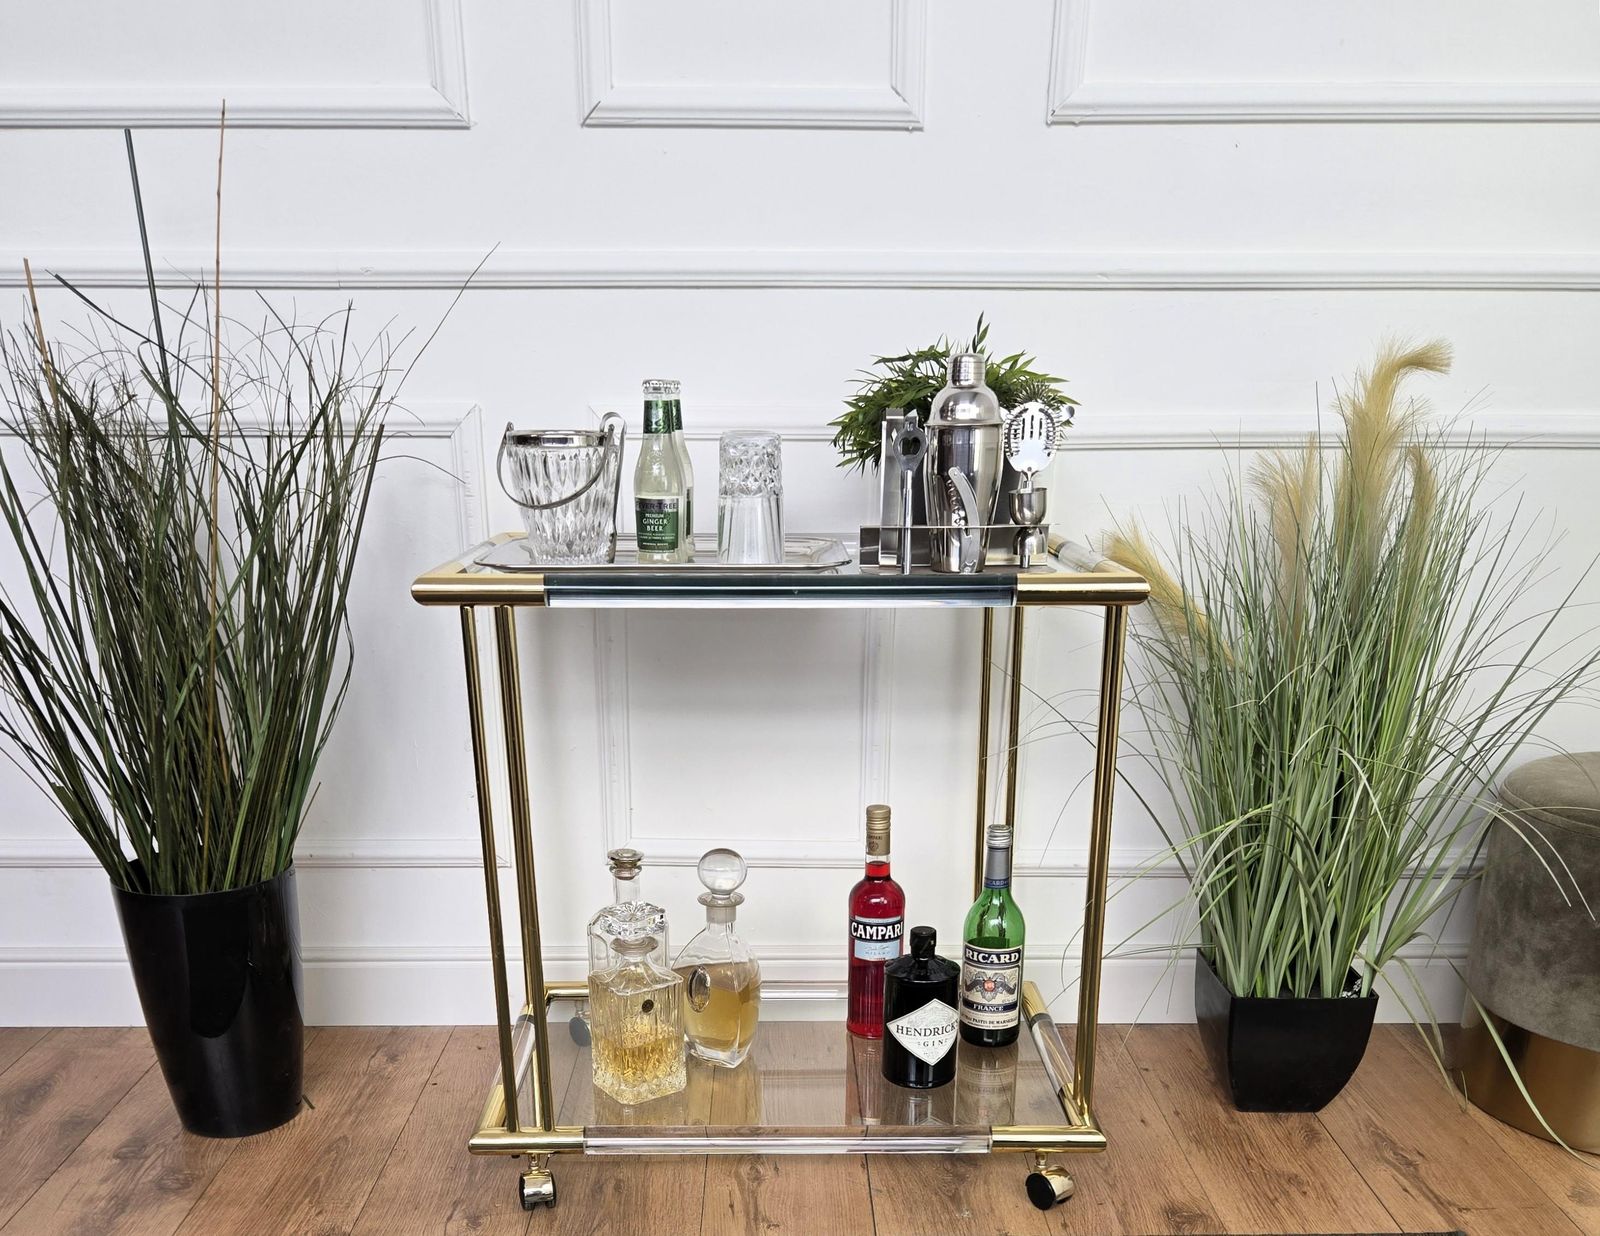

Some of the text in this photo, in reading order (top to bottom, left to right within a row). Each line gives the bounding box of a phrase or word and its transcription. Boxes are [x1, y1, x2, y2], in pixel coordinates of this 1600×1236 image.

[851, 921, 904, 940] CAMPARI
[965, 948, 1019, 964] RICARD
[973, 1003, 1004, 1012] FRANCE
[922, 1040, 944, 1048] GIN
